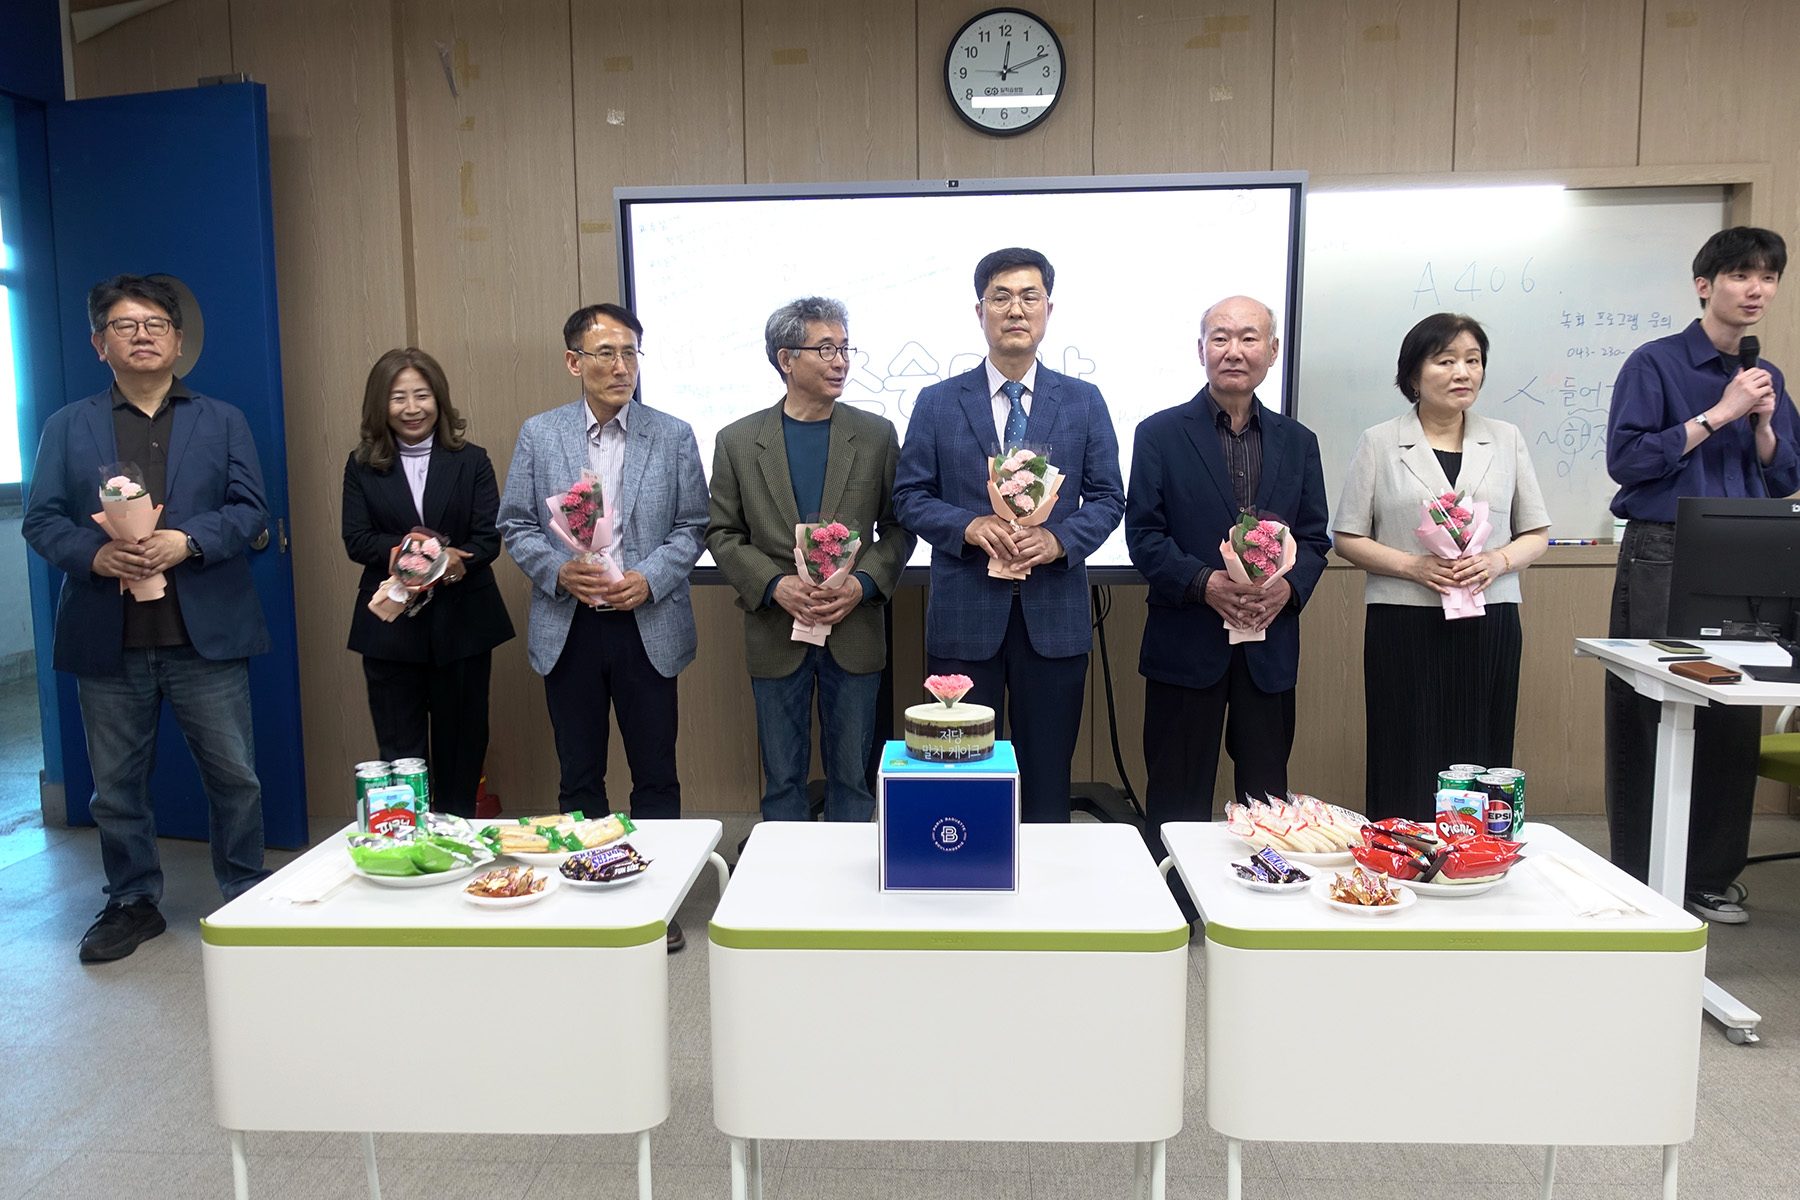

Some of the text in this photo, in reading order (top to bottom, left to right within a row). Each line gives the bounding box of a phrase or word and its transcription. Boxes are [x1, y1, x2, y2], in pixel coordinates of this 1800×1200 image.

[978, 31, 991, 42] 11
[999, 24, 1012, 37] 12
[1023, 31, 1029, 42] 1
[964, 46, 978, 58] 10
[1037, 45, 1045, 57] 2
[959, 67, 967, 79] 9
[1042, 66, 1050, 78] 3
[965, 88, 973, 100] 8
[1000, 108, 1008, 120] 6
[940, 728, 965, 745] 저당
[948, 744, 981, 759] 케이크
[1488, 812, 1511, 821] EPSI
